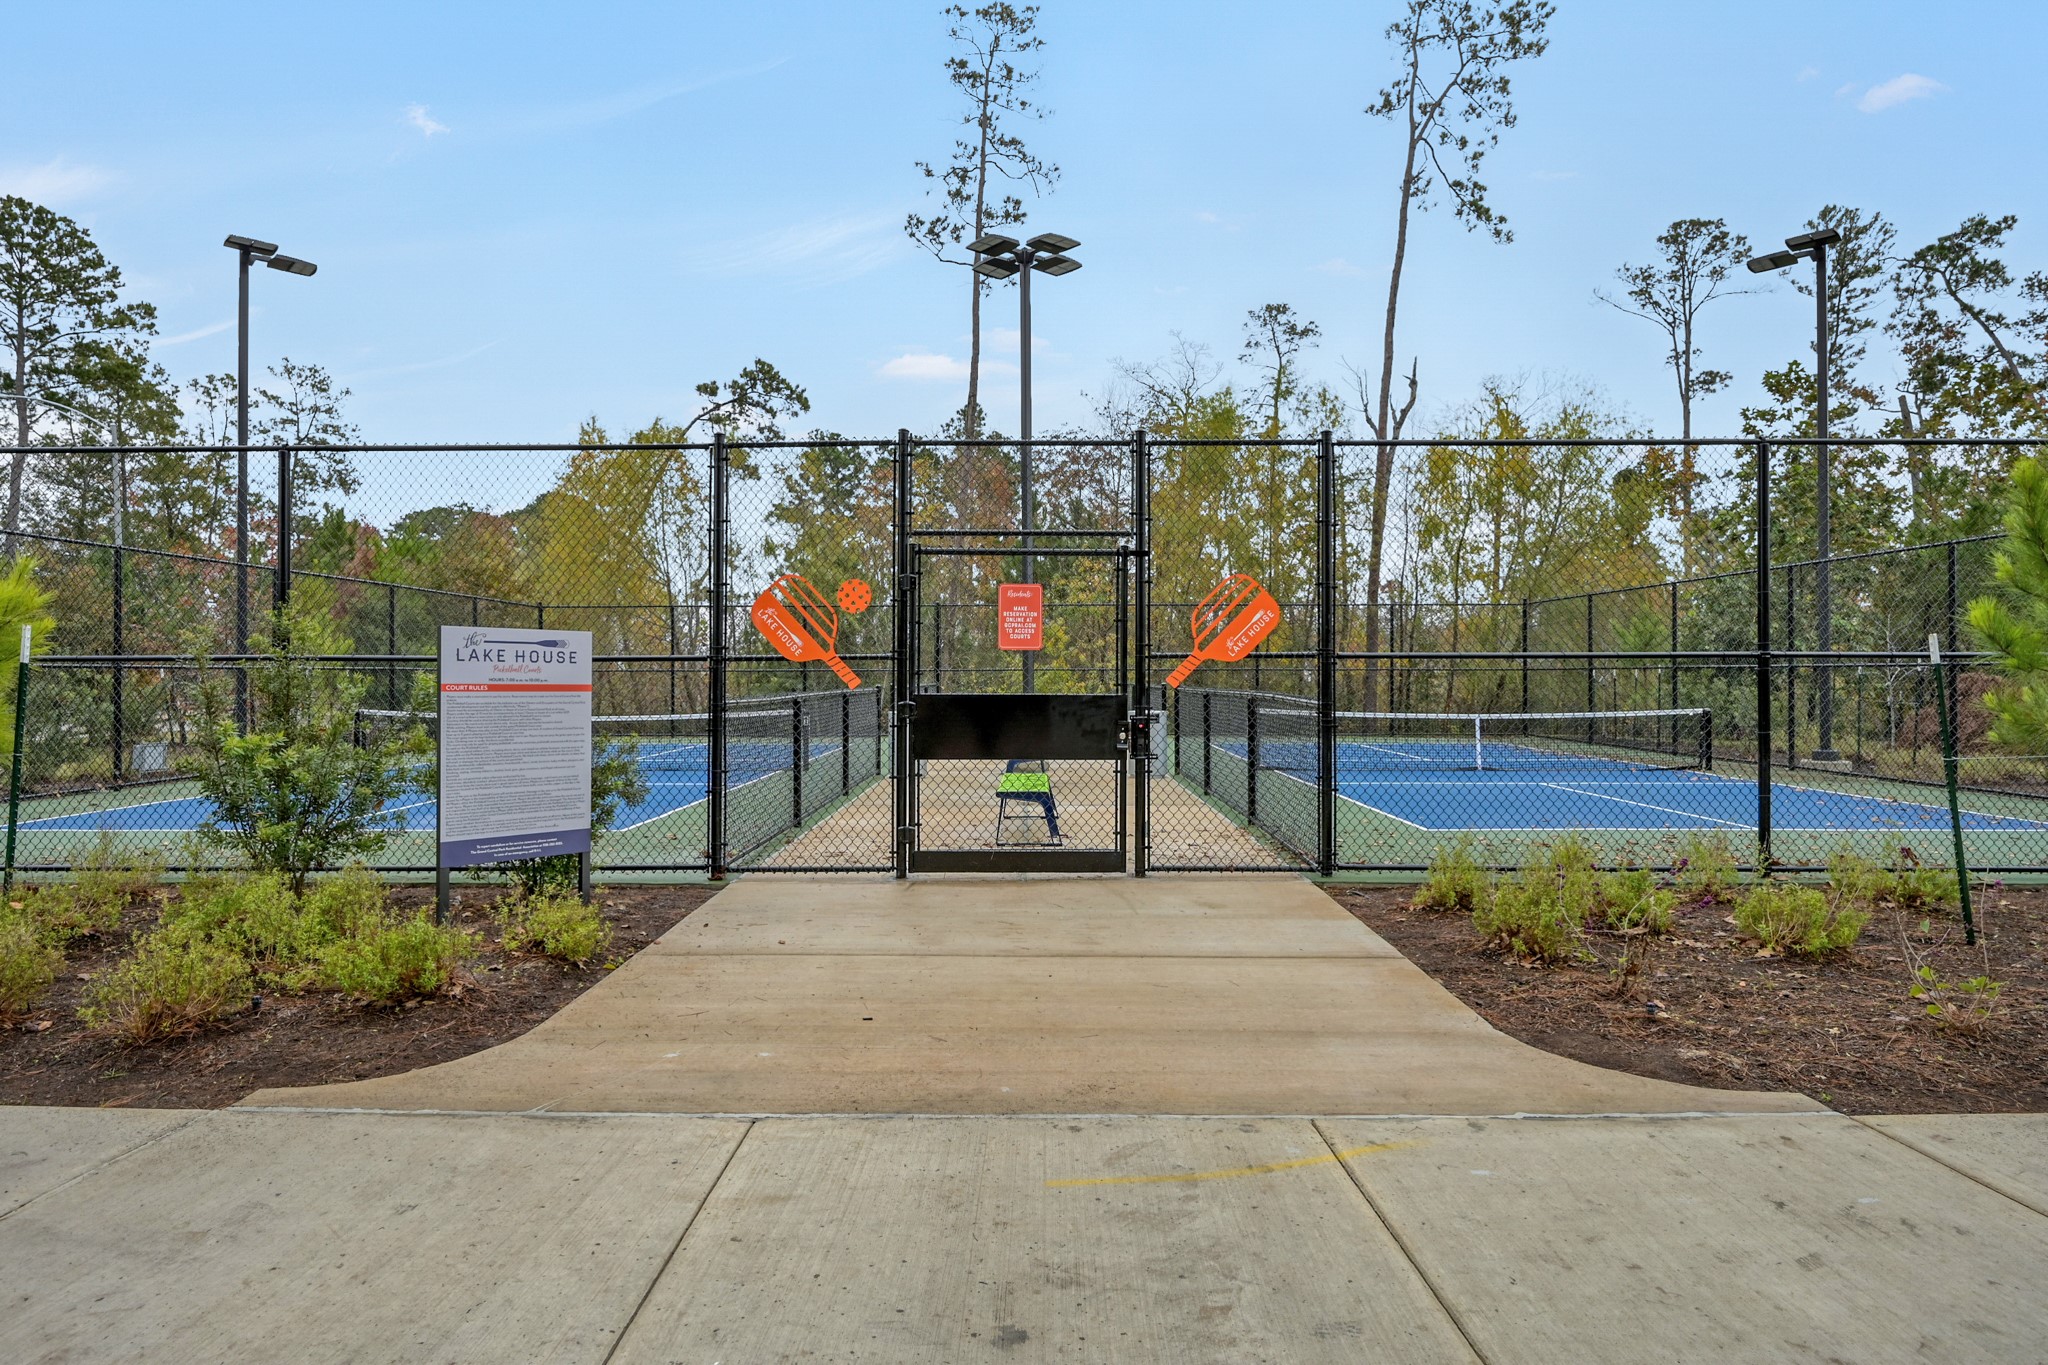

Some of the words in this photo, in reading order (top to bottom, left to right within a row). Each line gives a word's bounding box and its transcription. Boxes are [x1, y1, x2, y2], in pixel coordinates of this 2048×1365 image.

[456, 648, 506, 662] LAKE
[515, 650, 577, 664] HOUSE
[757, 609, 778, 631] LAKE
[776, 629, 803, 657] HOUSE
[1228, 635, 1249, 657] LAKE
[1247, 610, 1275, 637] HOUSE
